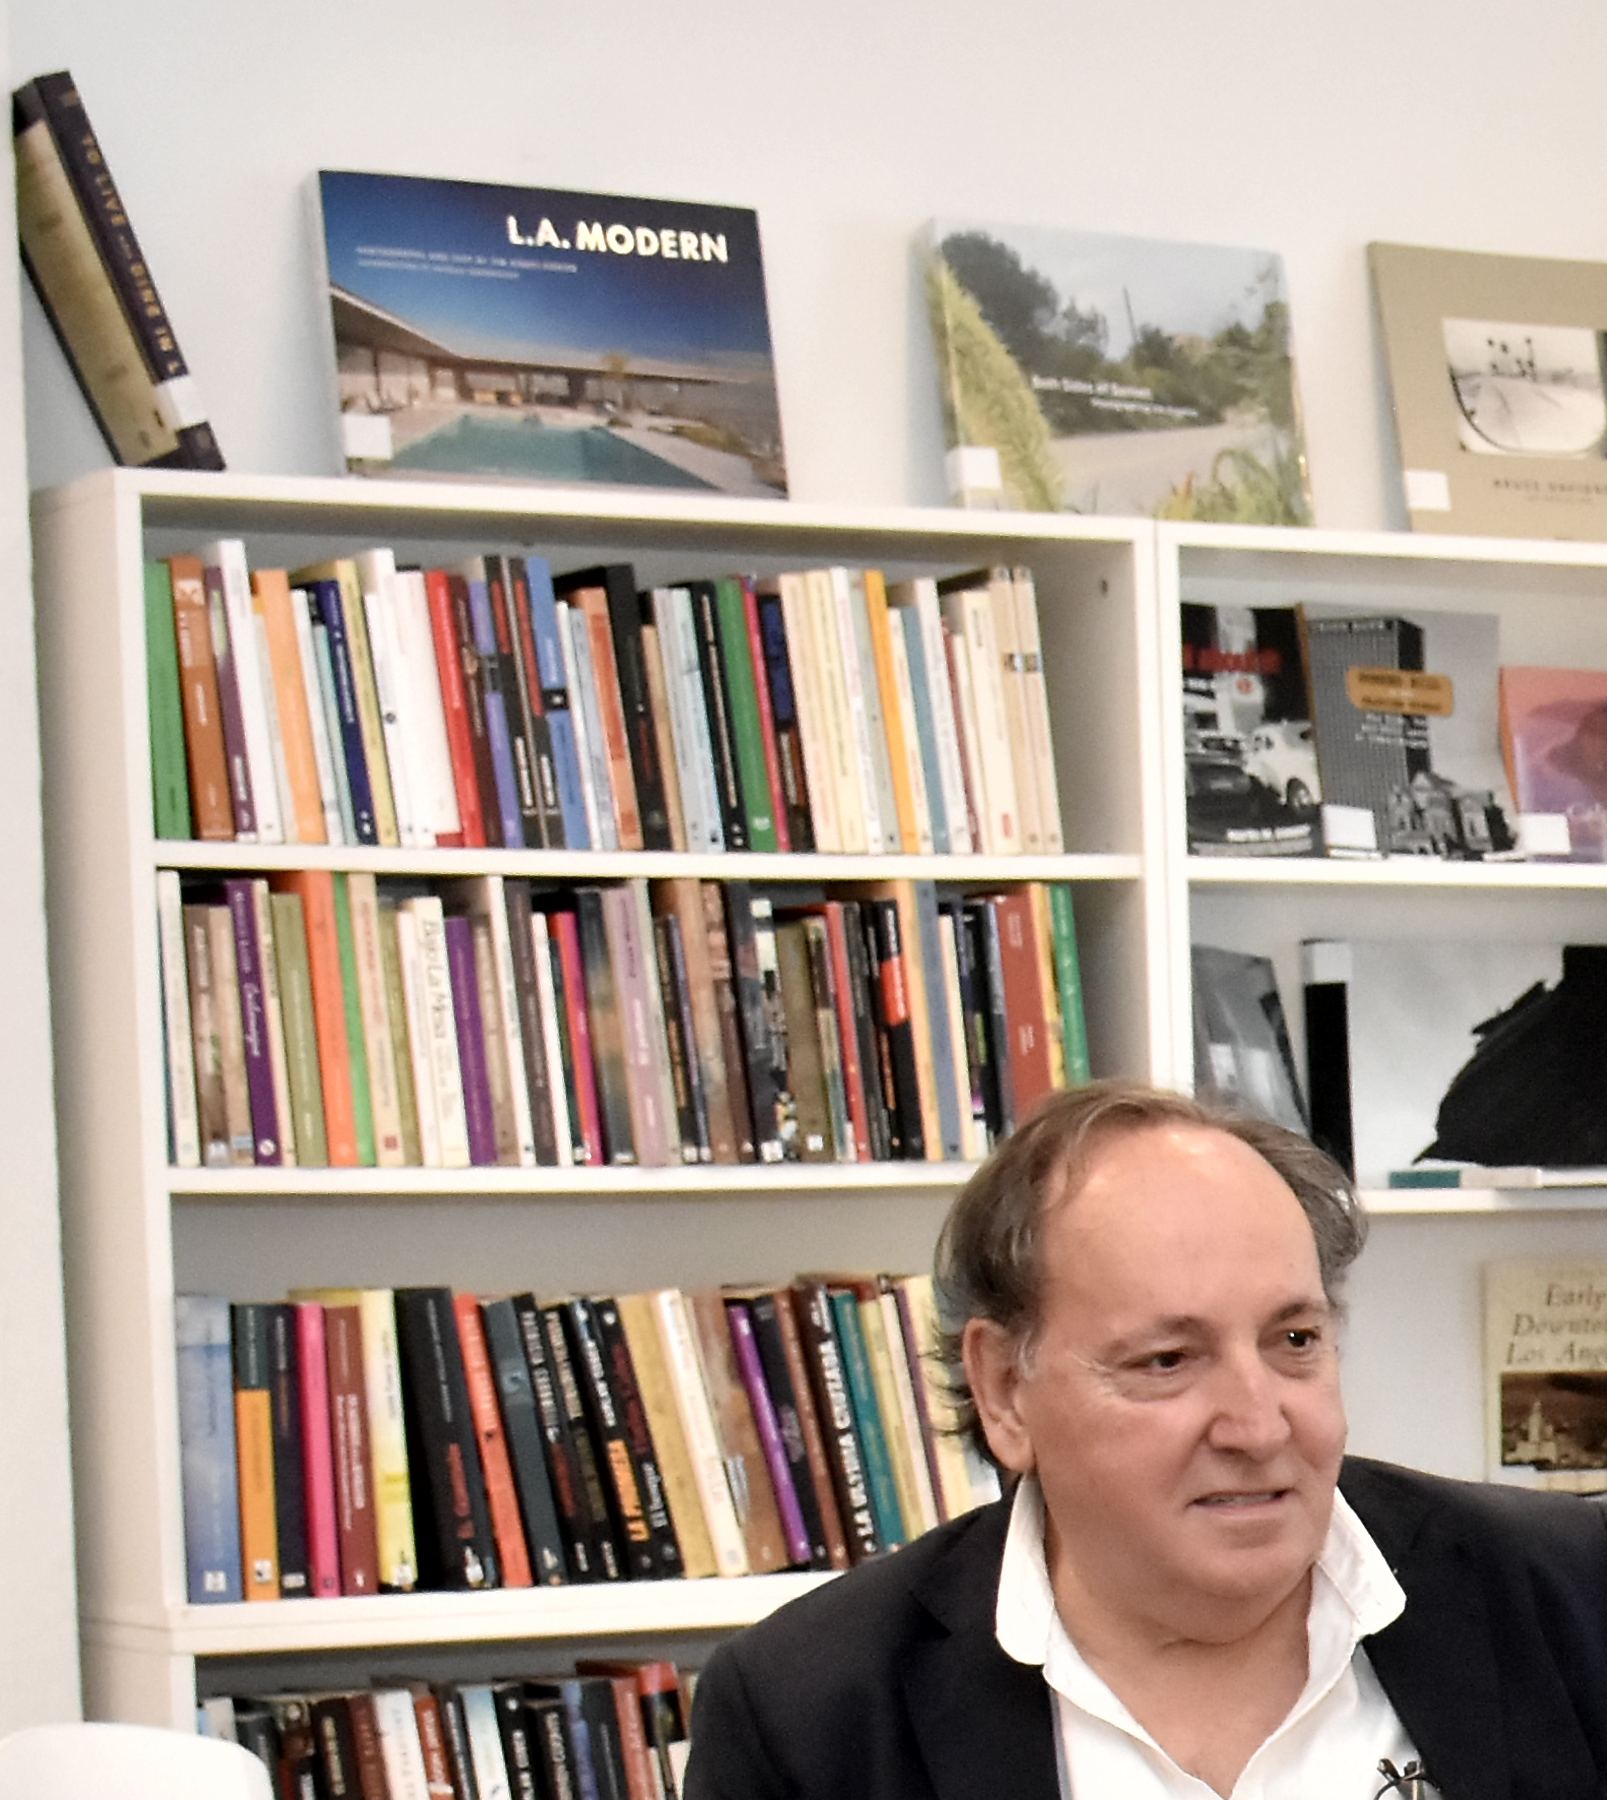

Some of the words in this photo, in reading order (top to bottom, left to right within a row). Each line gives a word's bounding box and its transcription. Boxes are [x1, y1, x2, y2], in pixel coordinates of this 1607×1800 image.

[507, 215, 570, 251] L.A.
[576, 220, 729, 264] MODERN
[1546, 1281, 1607, 1313] Early
[1506, 1340, 1545, 1365] Los
